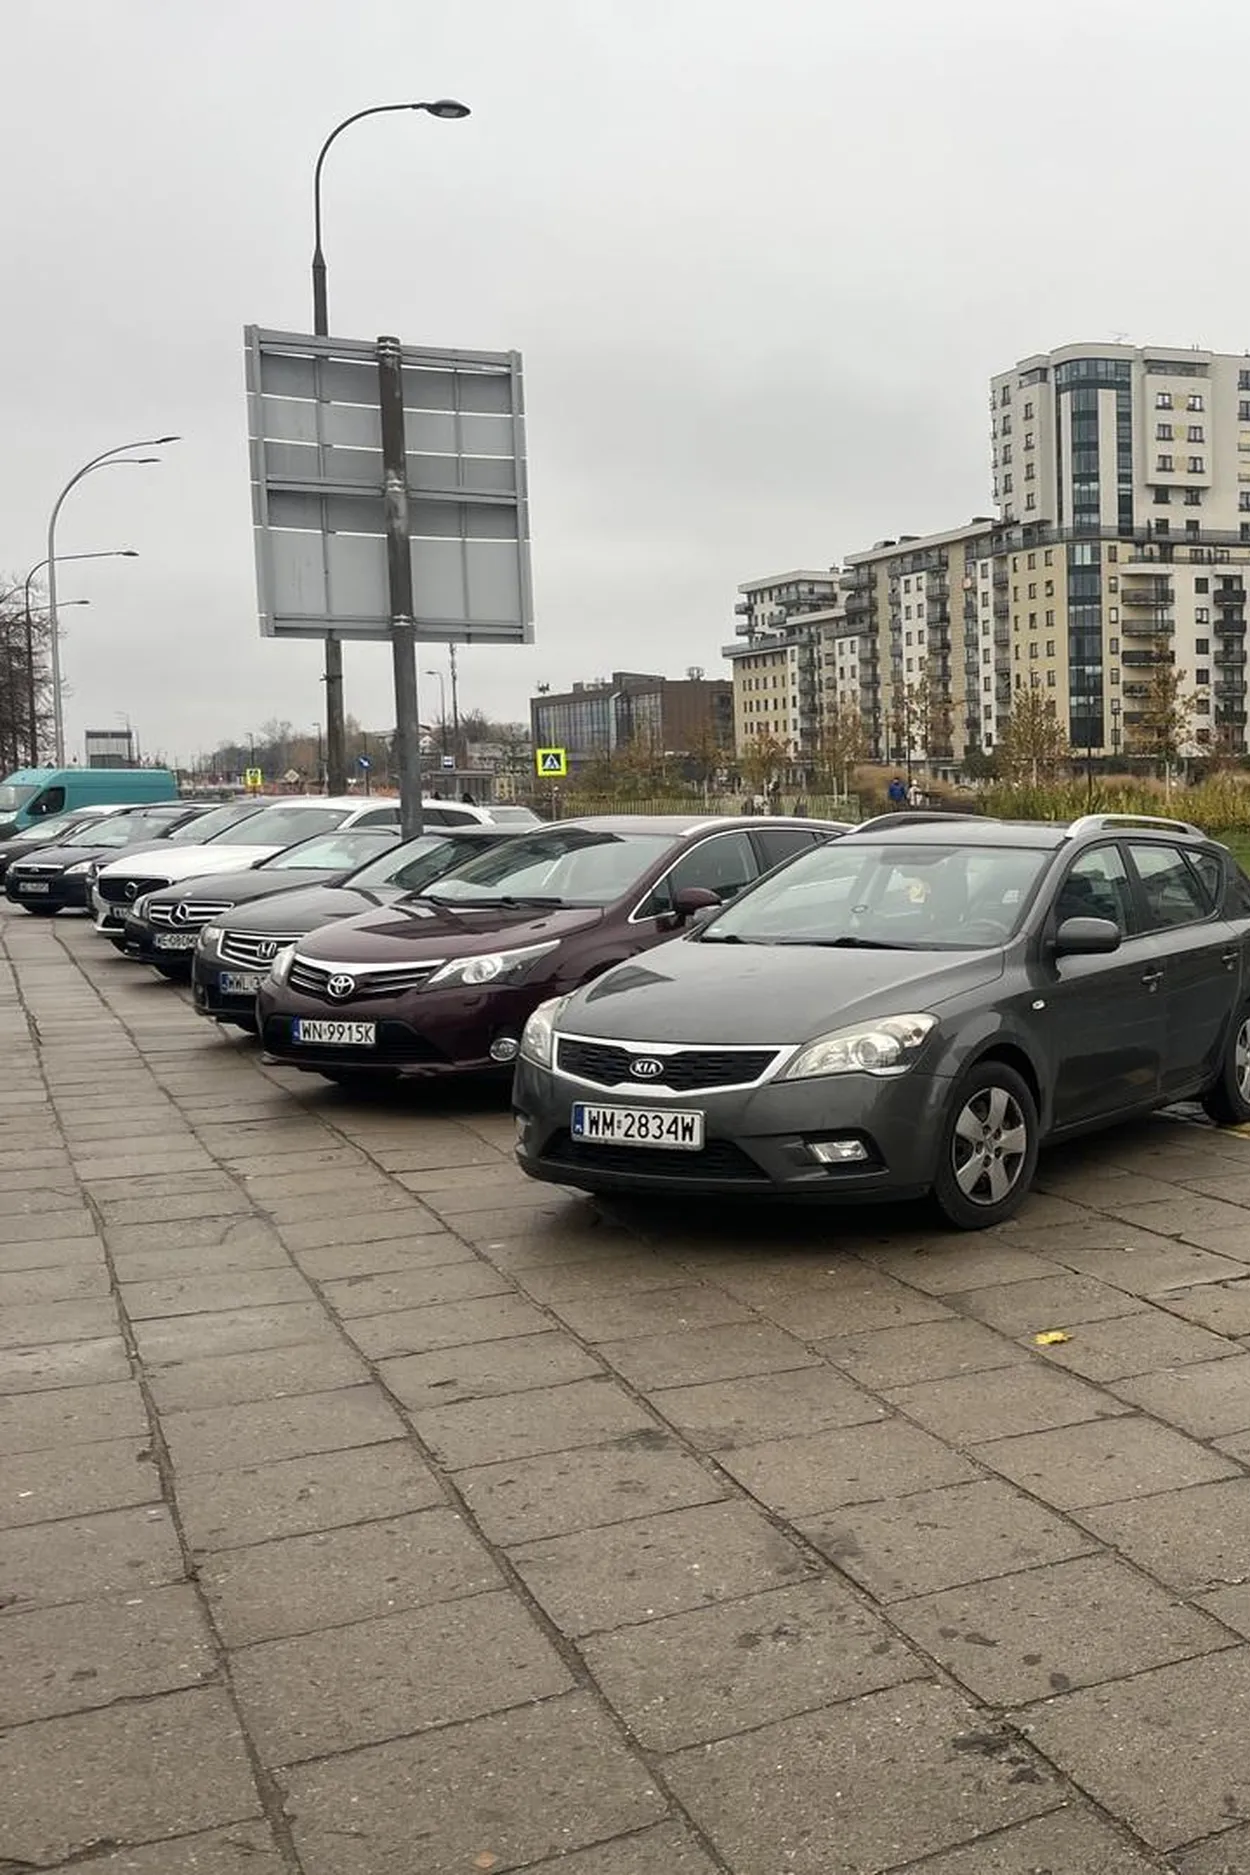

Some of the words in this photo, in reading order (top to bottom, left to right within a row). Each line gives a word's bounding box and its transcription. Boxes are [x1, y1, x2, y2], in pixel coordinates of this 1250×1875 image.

[302, 1022, 322, 1040] WN
[327, 1023, 373, 1042] 9915K
[634, 1062, 657, 1074] KIA
[588, 1110, 615, 1137] WM
[624, 1112, 695, 1142] 2834W
